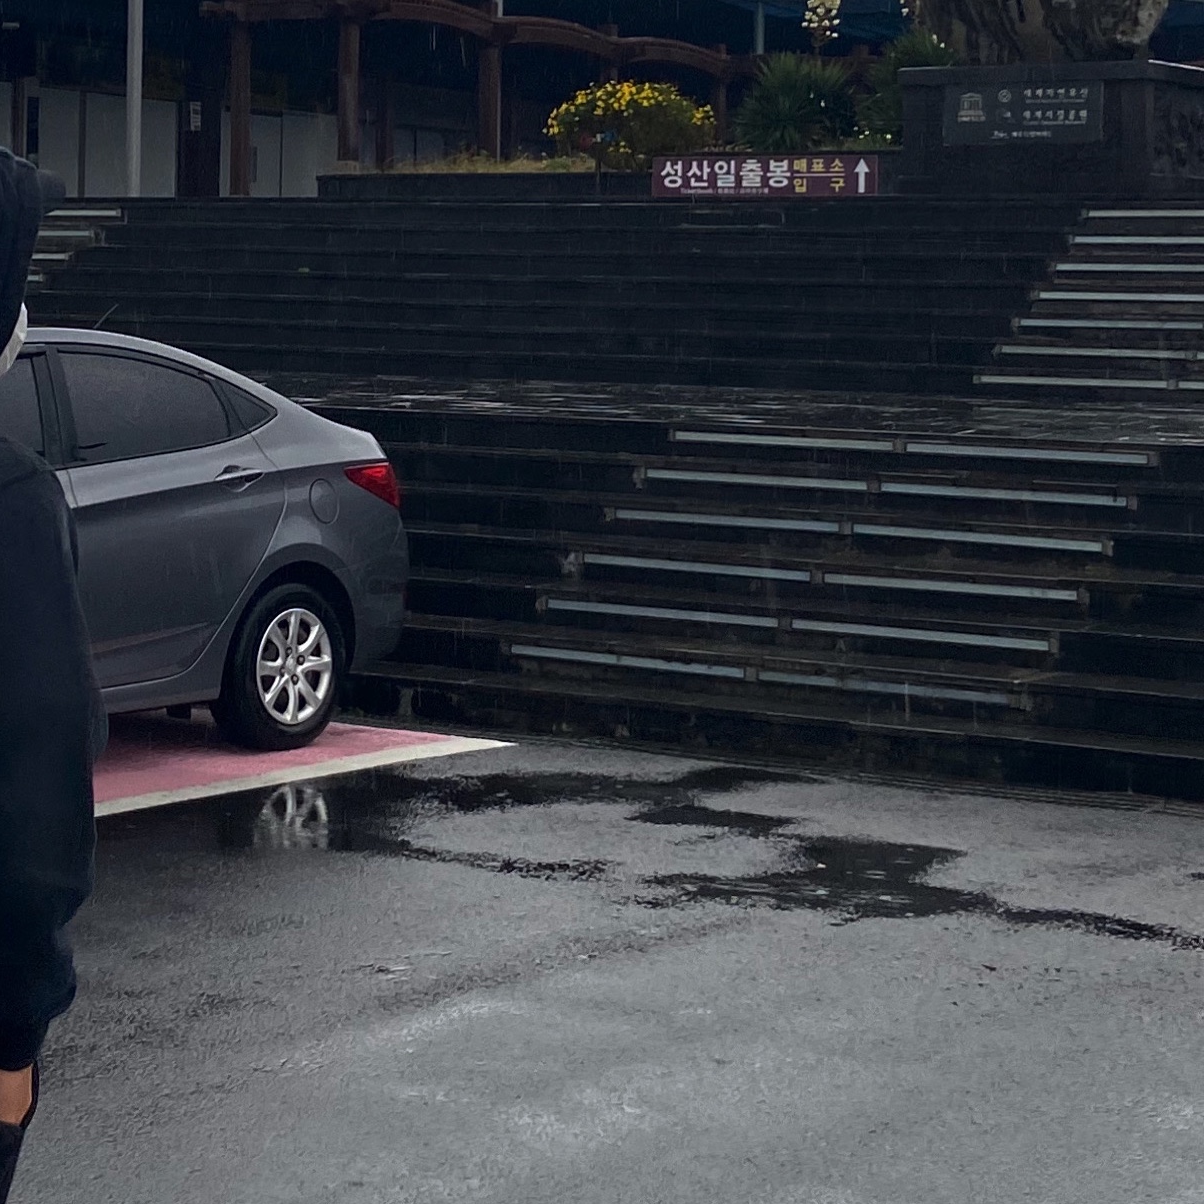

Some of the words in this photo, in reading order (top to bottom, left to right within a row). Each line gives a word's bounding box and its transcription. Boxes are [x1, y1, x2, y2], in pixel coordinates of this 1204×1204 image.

[793, 158, 845, 172] 매표소
[661, 159, 791, 188] 성산일출봉
[793, 178, 845, 193] 입구
